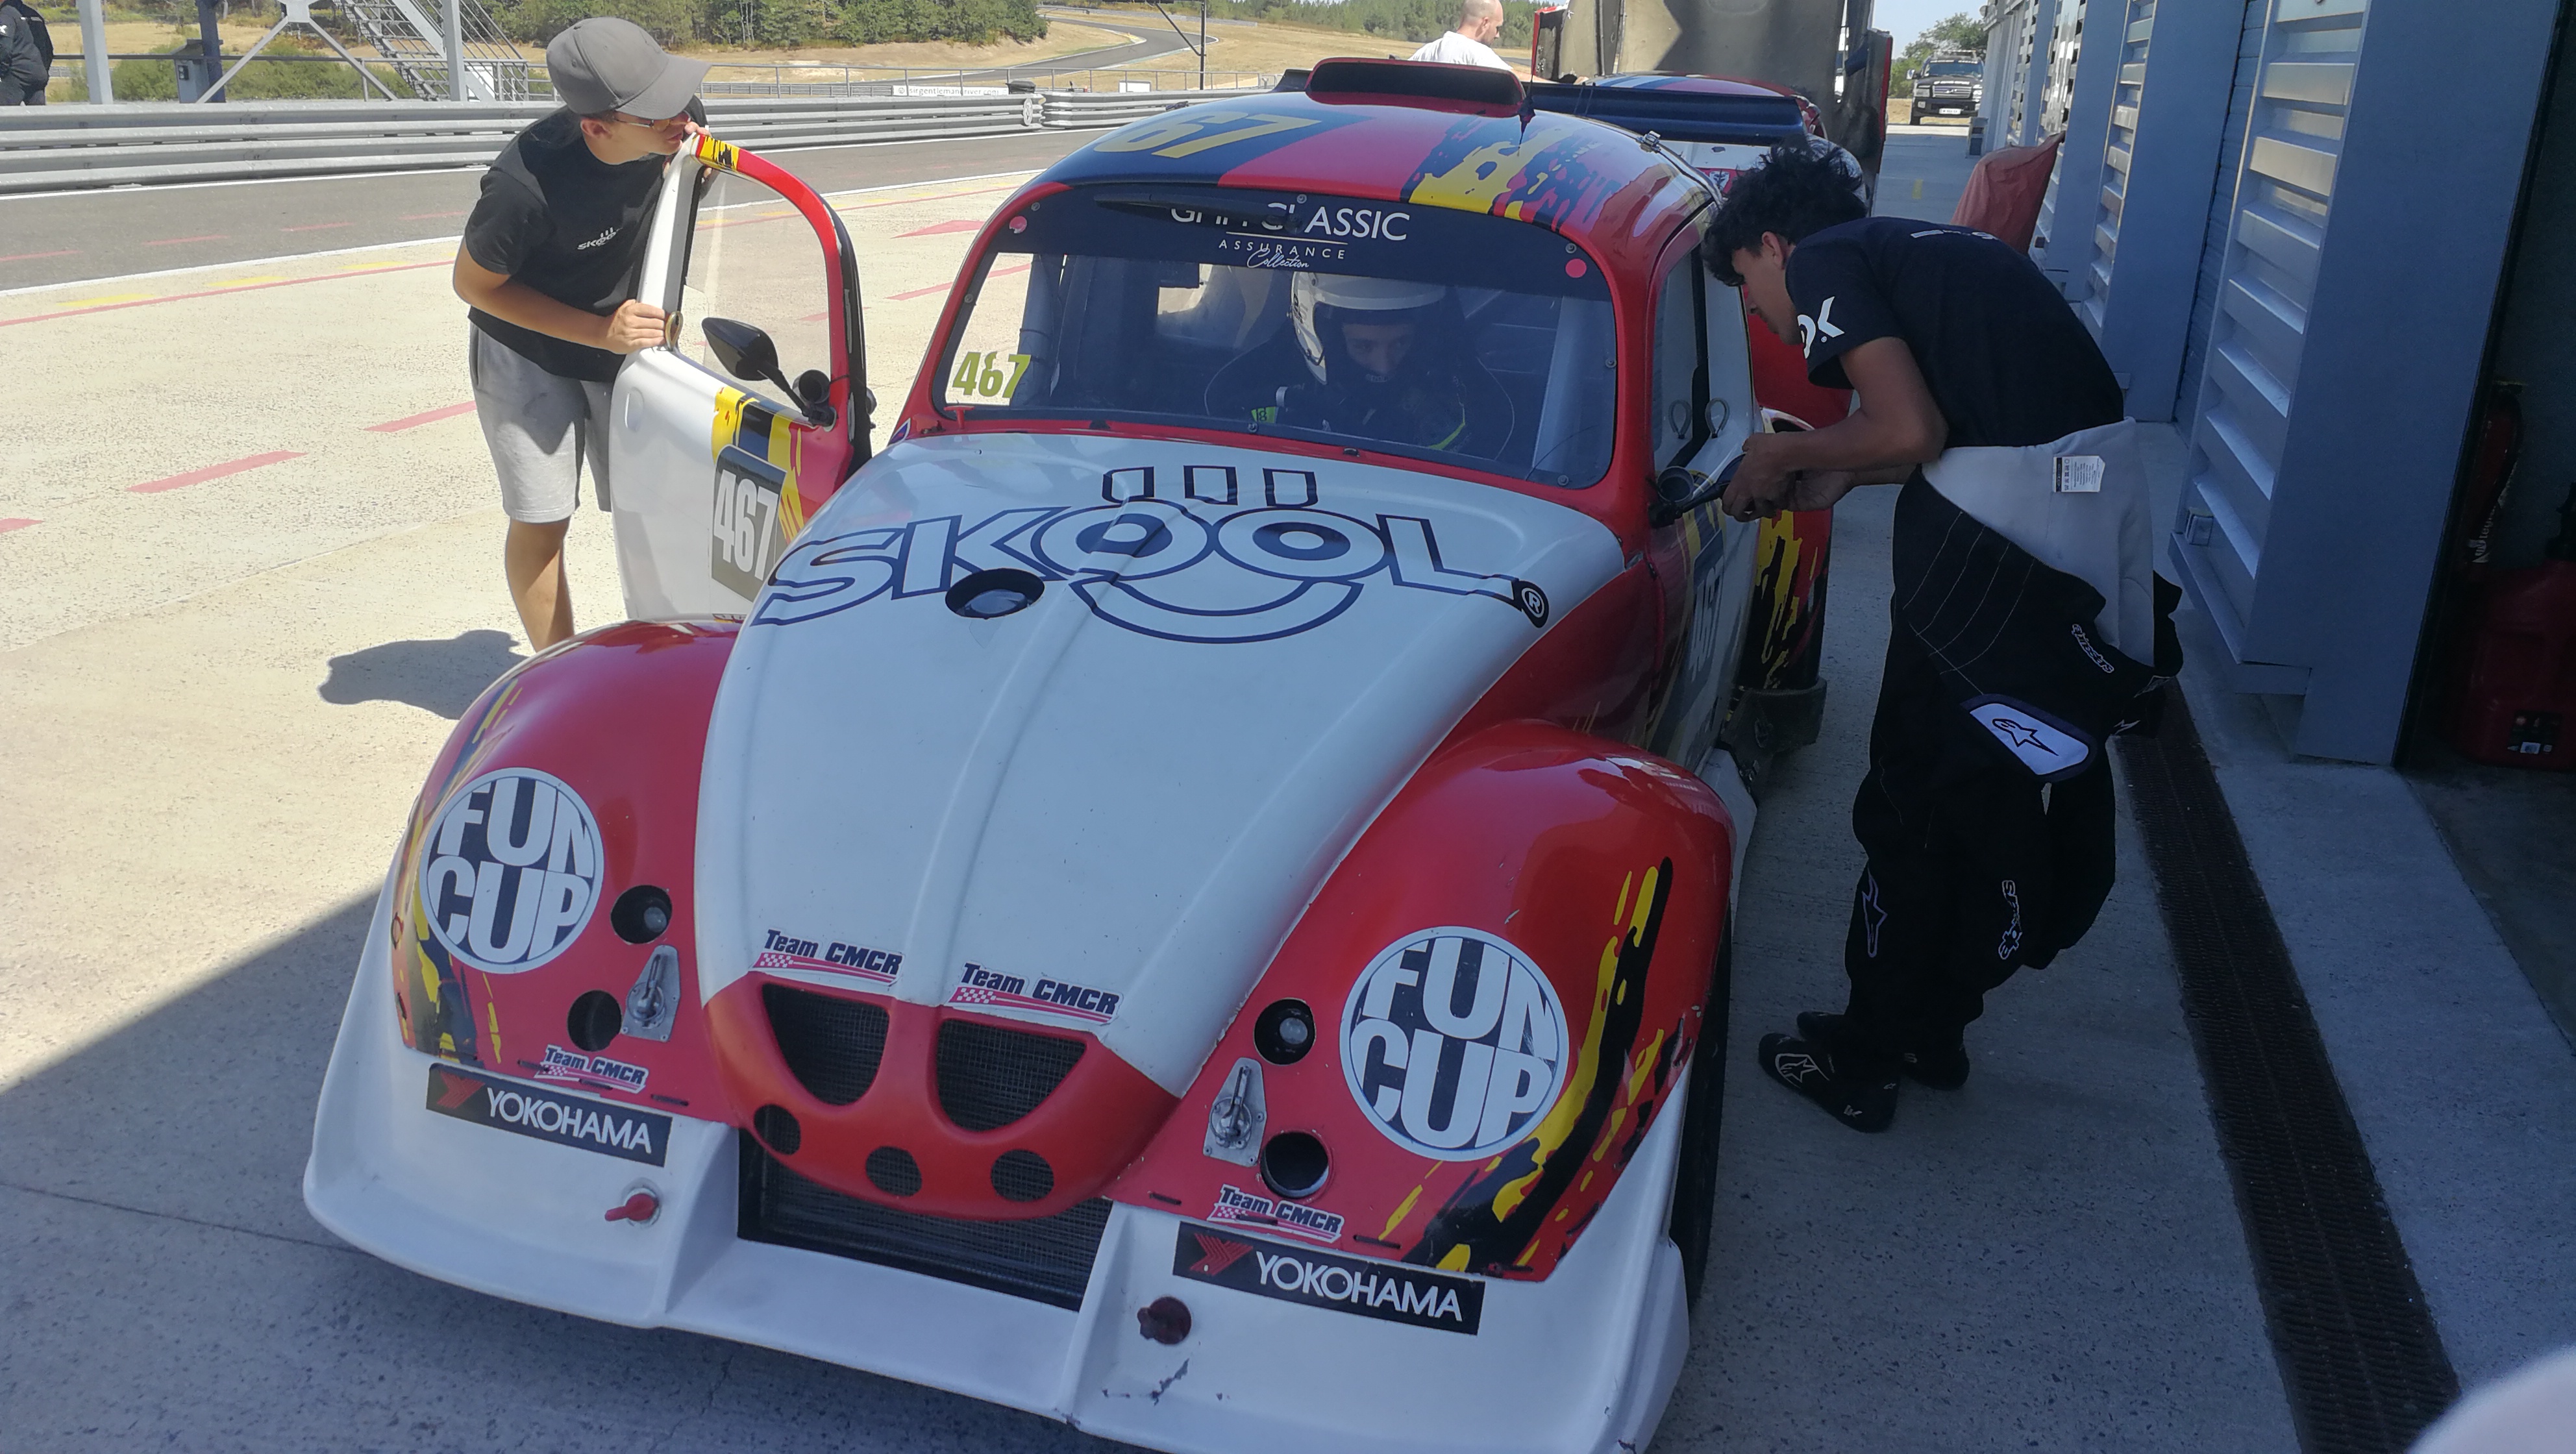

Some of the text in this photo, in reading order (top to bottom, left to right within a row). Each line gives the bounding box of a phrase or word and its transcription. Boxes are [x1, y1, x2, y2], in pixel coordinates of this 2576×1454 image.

[910, 86, 1000, 97] sirgentlemanrivercom
[577, 227, 623, 250] SKOO
[1219, 238, 1345, 260] ASSURANCE
[1246, 247, 1309, 268] Collection
[952, 351, 1032, 399] 467
[713, 469, 779, 581] 467
[437, 777, 593, 878] FUN
[427, 855, 590, 963] CUP
[764, 929, 902, 975] Team CMCR
[961, 963, 1120, 1015] Team CMCR
[1362, 937, 1557, 1061] FUN
[545, 1046, 647, 1083] Team CMCR
[1350, 1018, 1553, 1148] CUP
[487, 1087, 652, 1153] YOKOHAMA
[1219, 1187, 1343, 1233] Team CMCR
[1256, 1251, 1463, 1322] YOKOHAMA
